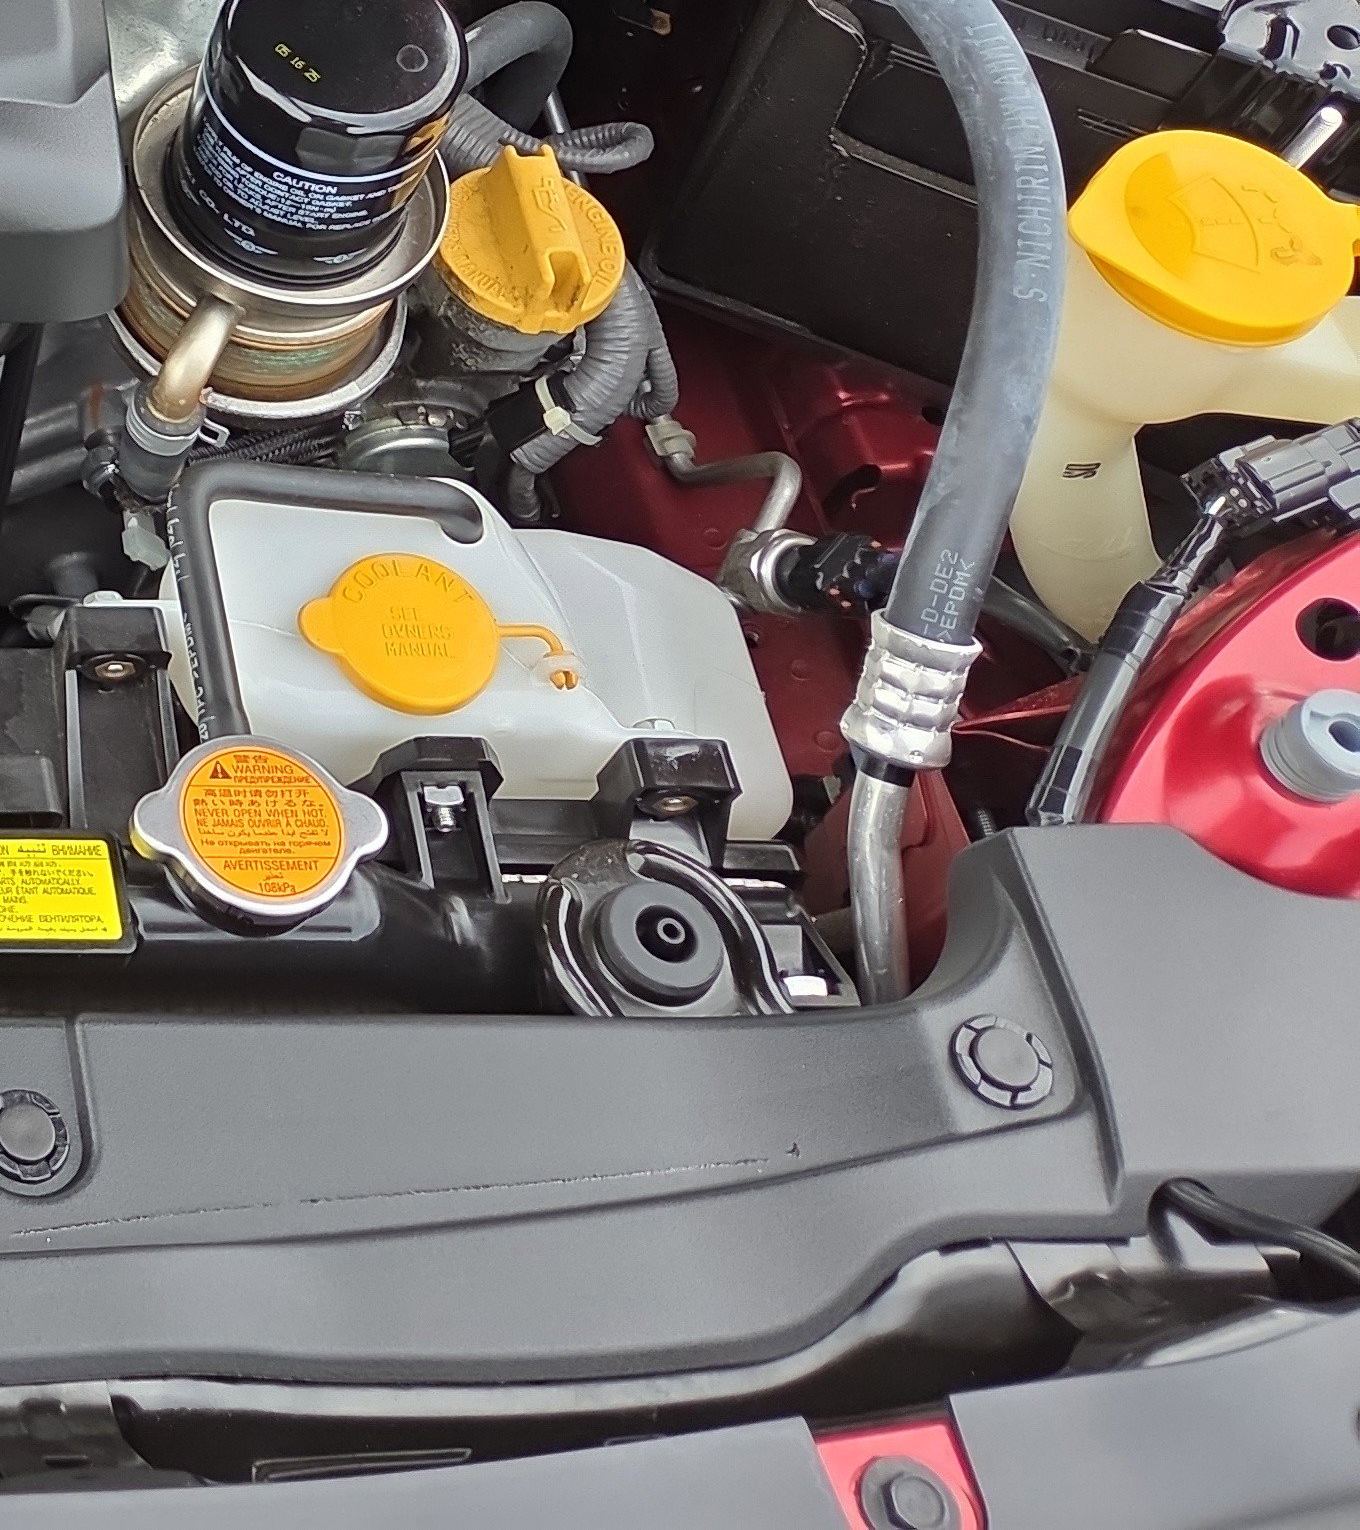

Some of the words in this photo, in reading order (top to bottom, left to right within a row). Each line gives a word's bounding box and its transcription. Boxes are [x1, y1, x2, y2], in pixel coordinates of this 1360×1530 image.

[273, 171, 338, 194] CAUTION
[342, 559, 474, 604] COOLANT
[384, 641, 456, 659] MANUAL
[231, 764, 294, 775] WARNING
[194, 808, 232, 818] NEVER
[233, 808, 262, 818] OPEN
[266, 808, 299, 818] WHEN
[196, 818, 209, 827] NE
[212, 818, 244, 828] JAMAIS
[248, 818, 282, 828] OUVRIR
[223, 860, 320, 871] AVERTISSEMENT
